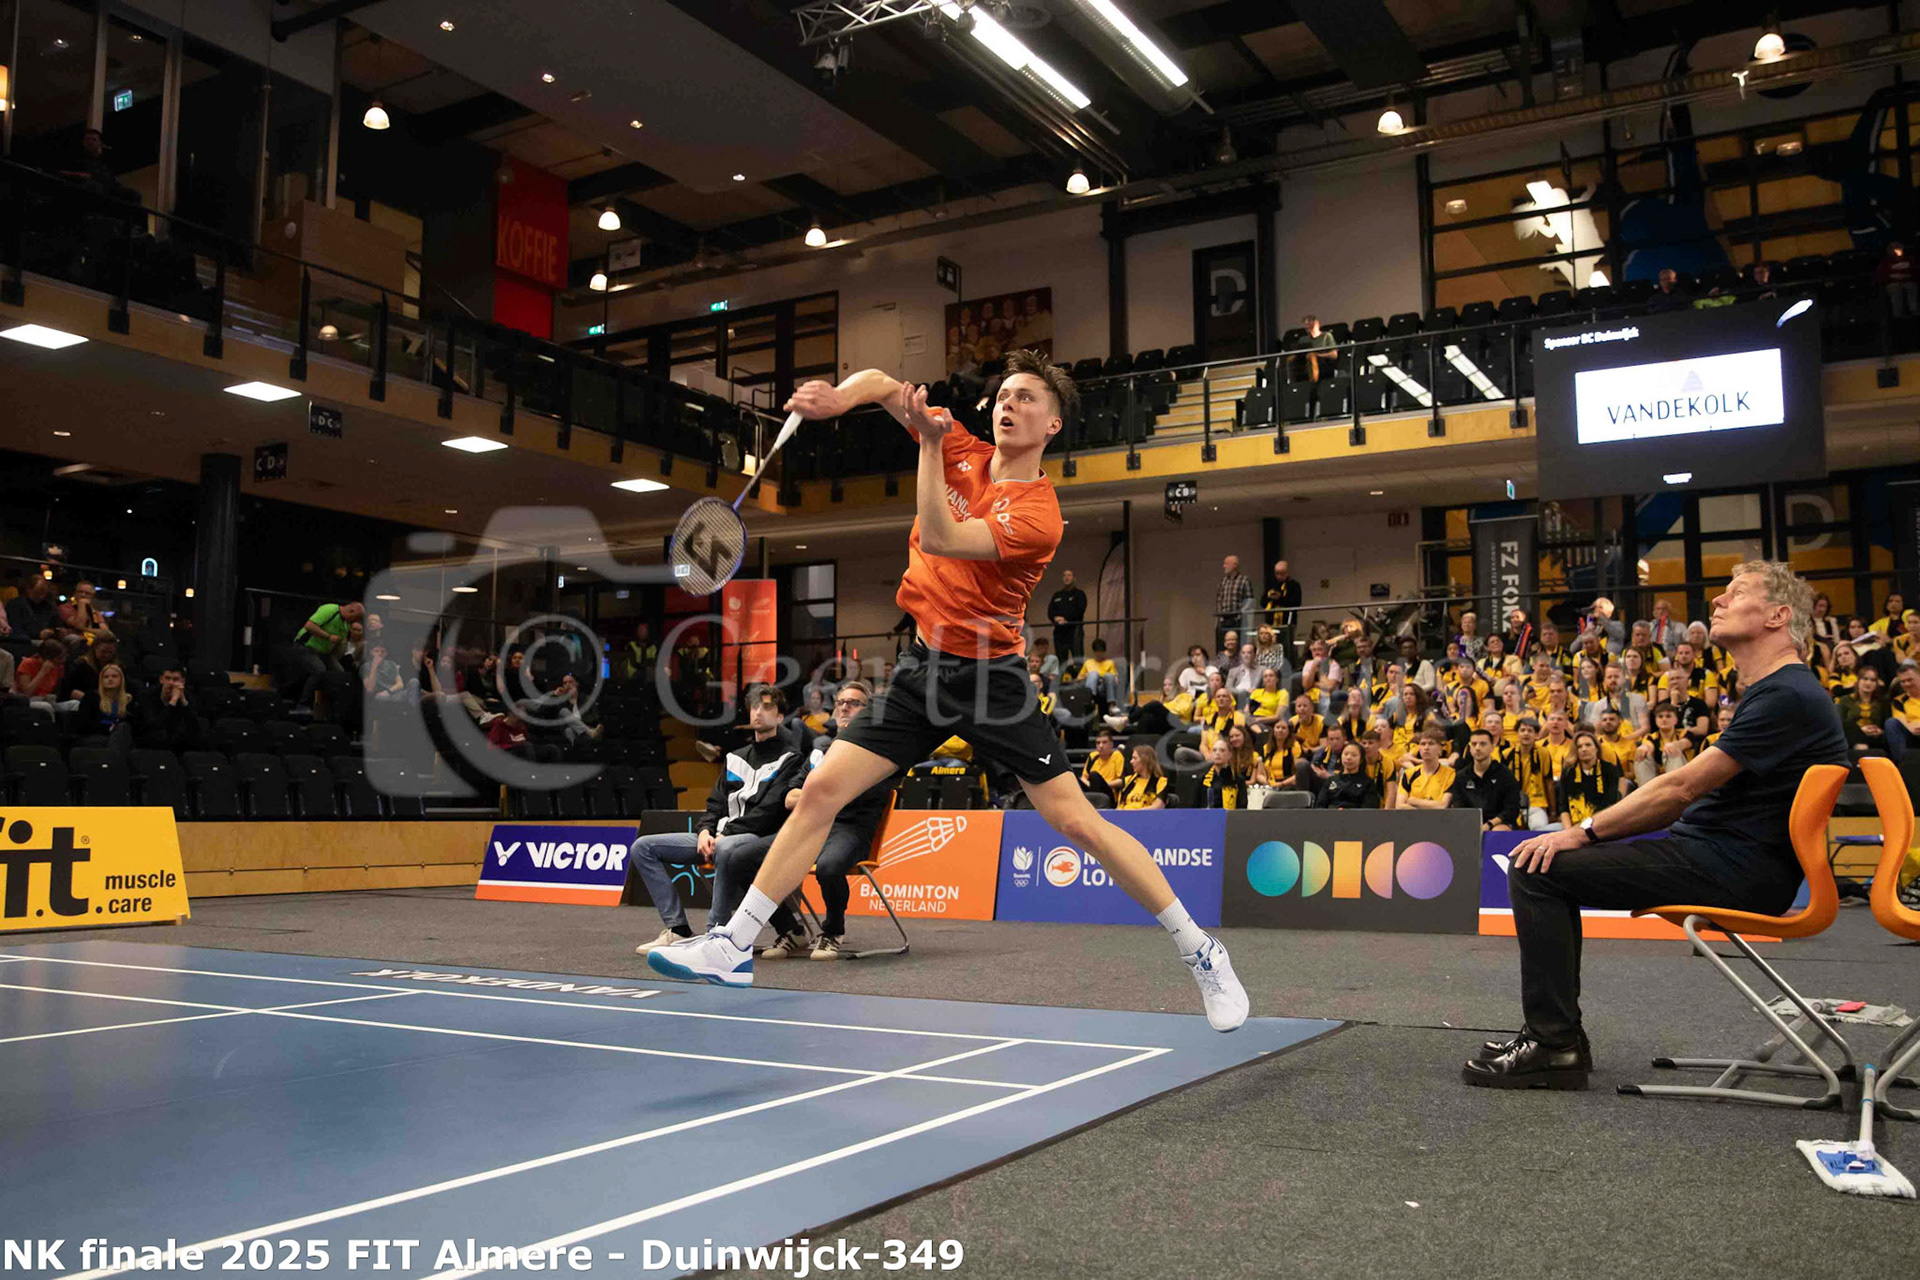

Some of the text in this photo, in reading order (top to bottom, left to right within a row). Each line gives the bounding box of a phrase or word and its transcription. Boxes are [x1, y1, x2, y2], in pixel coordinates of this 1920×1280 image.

[497, 214, 558, 284] KOFFIE
[1607, 391, 1750, 425] VANDEKOLK
[1500, 541, 1519, 568] FZ
[525, 841, 628, 871] VICTOR
[105, 870, 176, 890] muscle
[860, 883, 960, 900] BADMINTON
[869, 899, 947, 913] NEDERLAND
